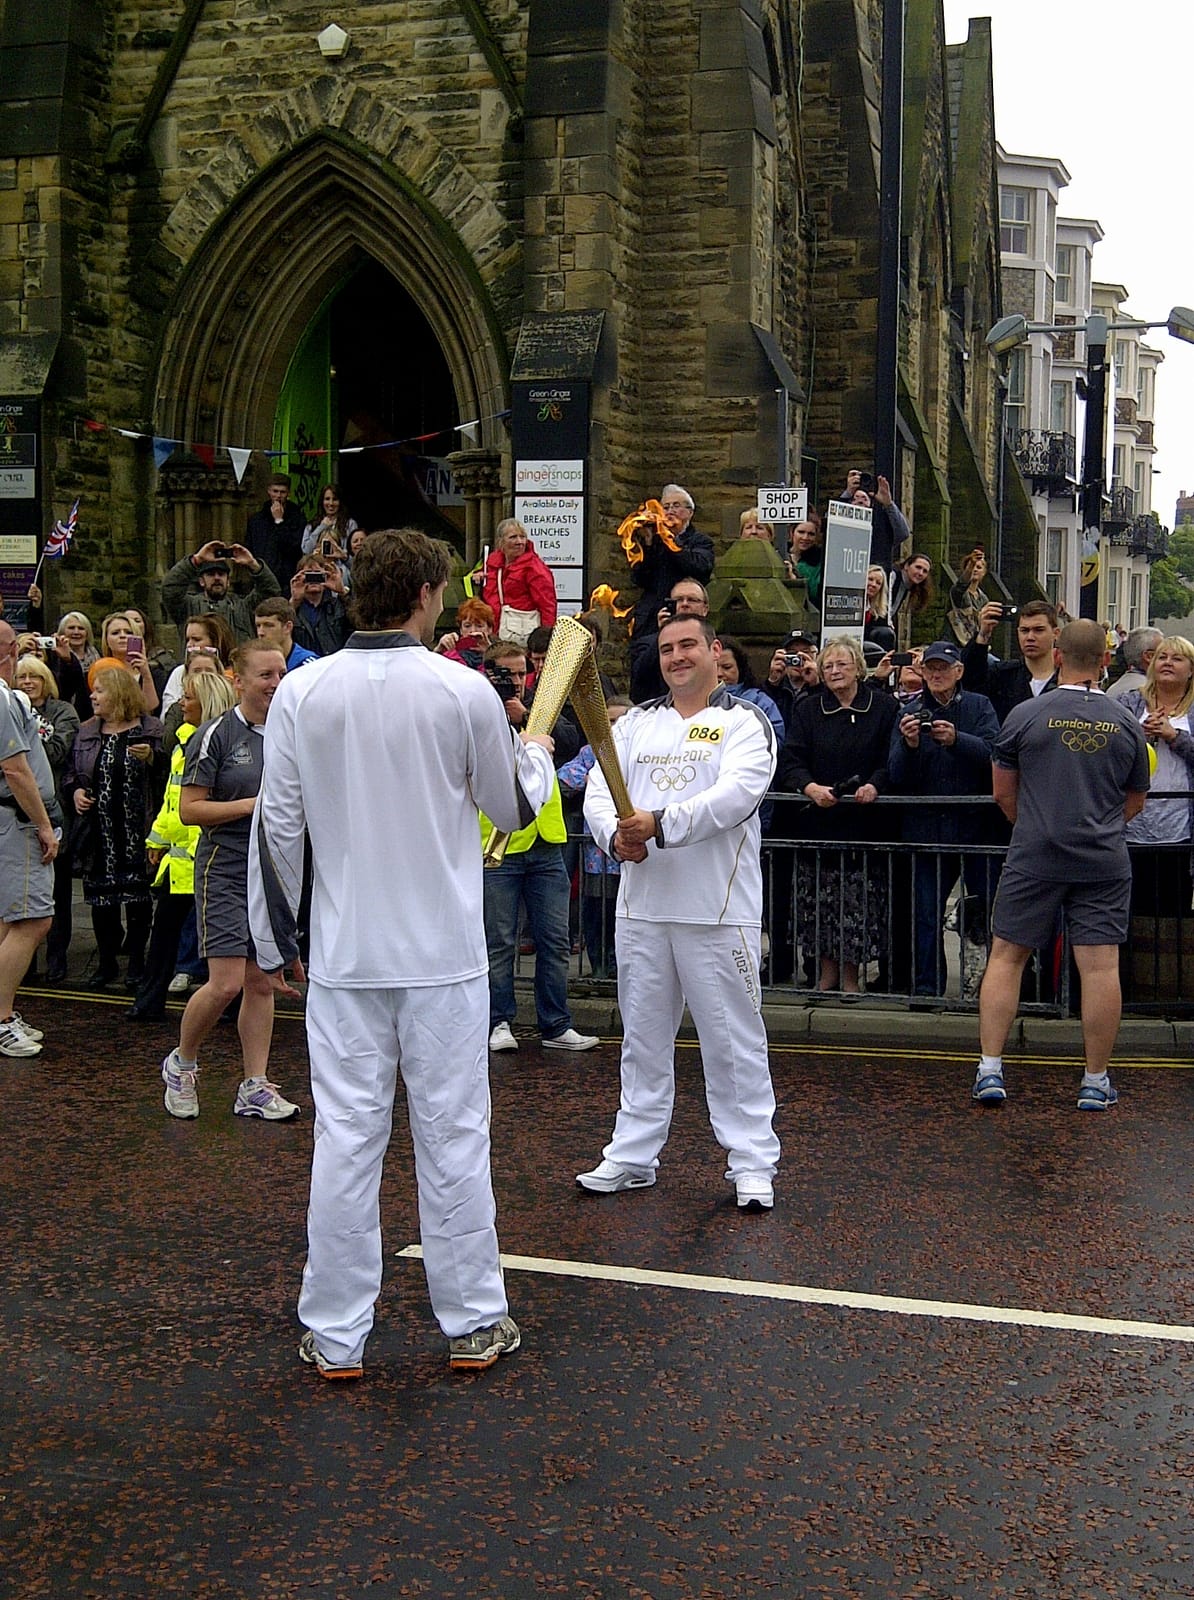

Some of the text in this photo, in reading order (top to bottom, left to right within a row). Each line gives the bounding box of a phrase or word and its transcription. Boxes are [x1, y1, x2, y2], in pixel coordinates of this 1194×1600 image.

[528, 389, 571, 399] Green Ginger
[517, 468, 582, 482] gingersnaps
[766, 492, 799, 504] SHOP
[522, 499, 579, 510] Available Daily
[761, 506, 803, 519] TO LET
[523, 515, 578, 524] BREAKFASTS
[530, 527, 570, 537] LUNCHES
[539, 540, 561, 549] TEAS
[843, 548, 868, 574] TO LET
[1048, 718, 1121, 734] London 2012
[689, 727, 721, 741] 086
[682, 750, 713, 762] 2012
[731, 948, 749, 975] 2012
